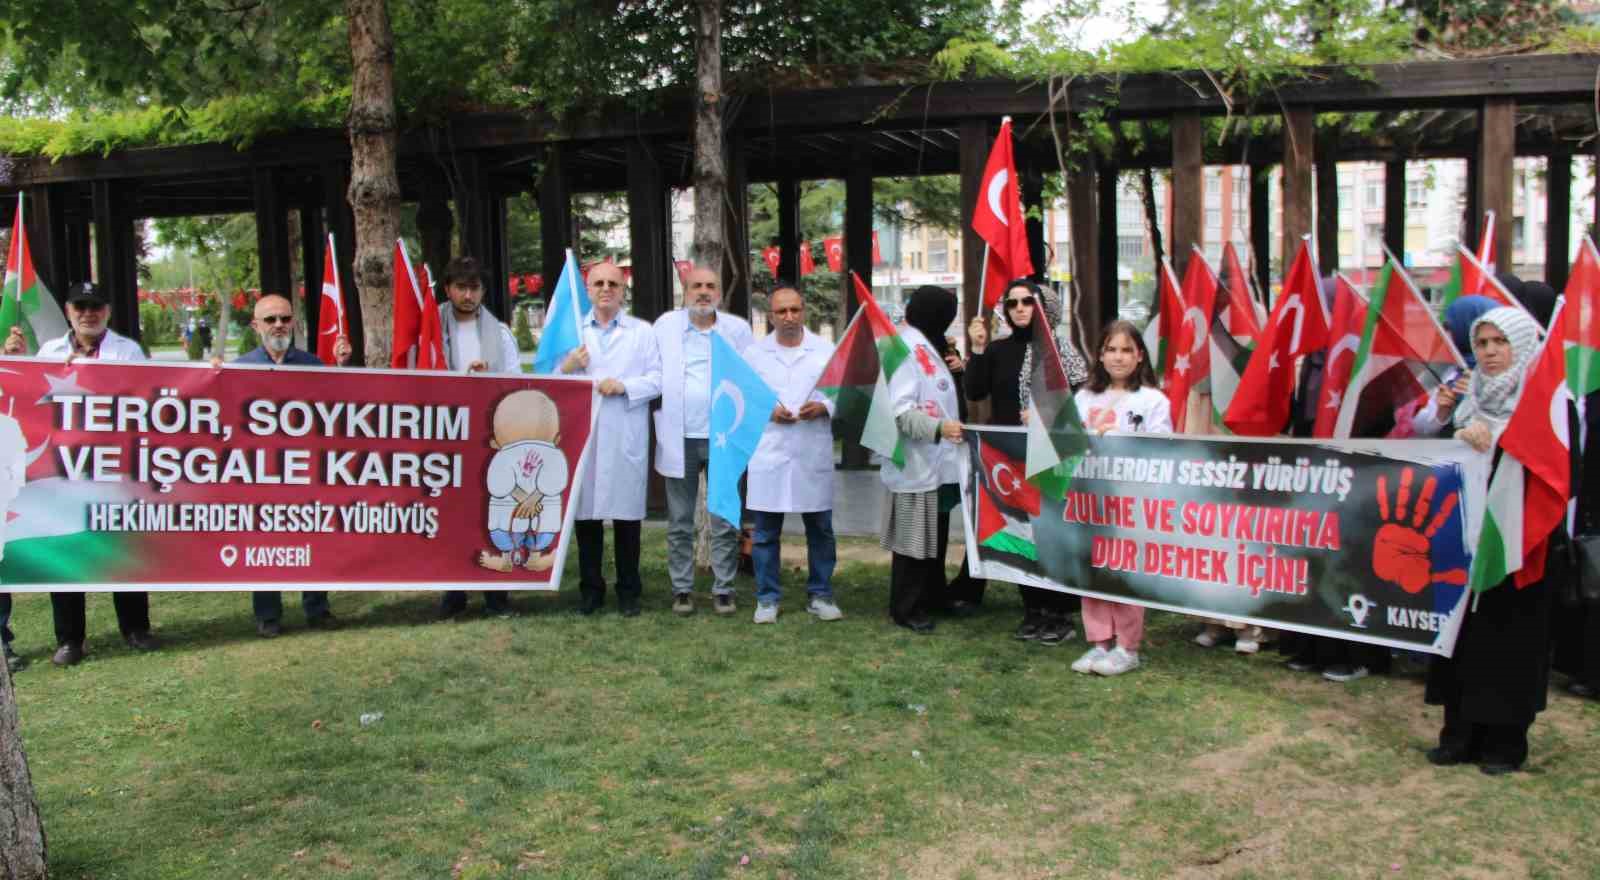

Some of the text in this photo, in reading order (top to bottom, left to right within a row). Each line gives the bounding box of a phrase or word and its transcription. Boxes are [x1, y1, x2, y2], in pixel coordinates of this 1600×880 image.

[52, 388, 470, 441] TERÖR, SOYKIRIM
[59, 438, 463, 497] VE İŞGALE KARŞI
[1177, 454, 1249, 489] SESSİZ
[1252, 456, 1355, 501] YÜRÜYÜŞ
[90, 499, 440, 539] HEKİMLERDEN SESSİZ YÜRÜYÜŞ
[1063, 489, 1342, 551] ZULME VE SOYKIRIMA
[245, 543, 312, 567] KAYSERİ
[1091, 533, 1309, 599] DUR DEMEK İÇİN!
